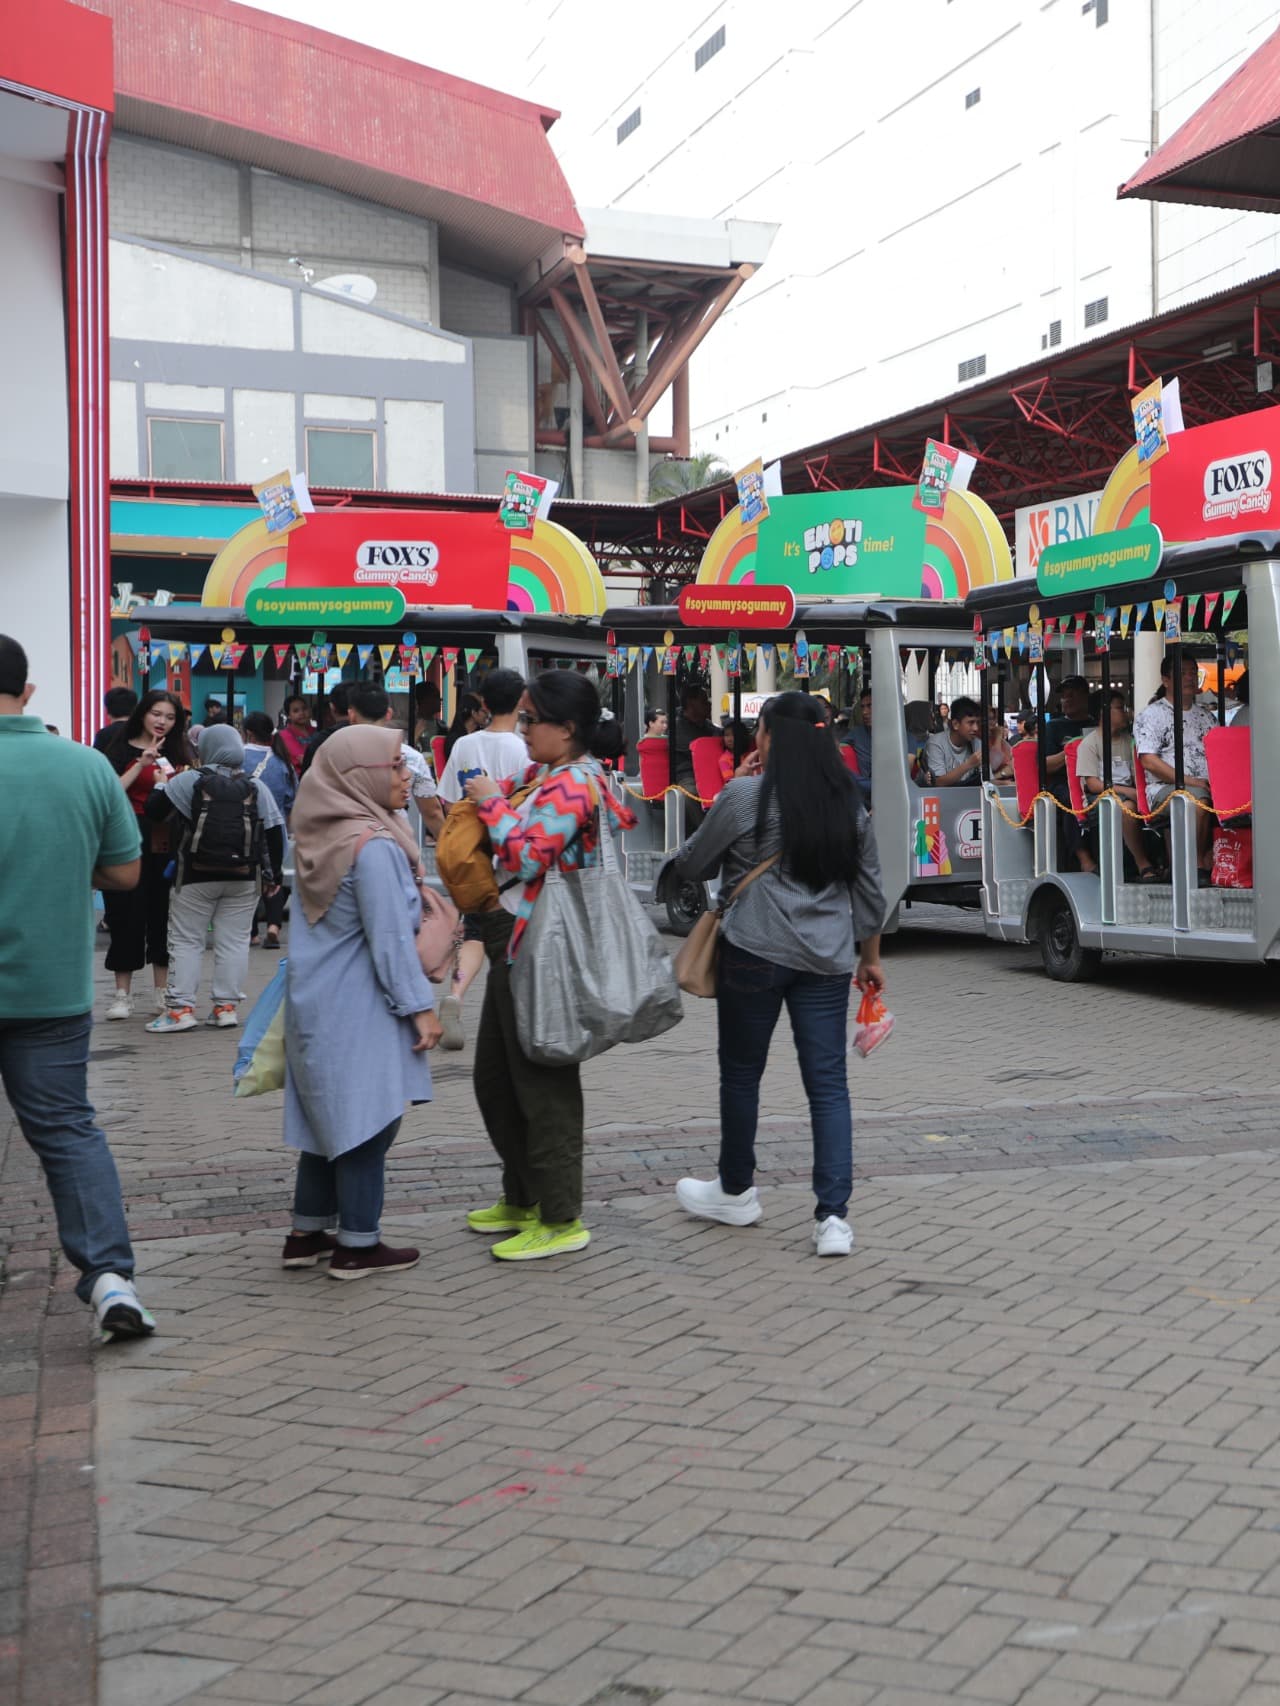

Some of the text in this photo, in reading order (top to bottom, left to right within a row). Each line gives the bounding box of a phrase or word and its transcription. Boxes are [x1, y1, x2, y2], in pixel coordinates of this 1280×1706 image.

[1211, 458, 1265, 496] FOX'S
[1204, 491, 1270, 518] Gummy Candy
[366, 546, 431, 567] FOX'S
[784, 541, 800, 556] It's
[808, 545, 858, 574] POPS
[863, 536, 895, 552] time!
[1043, 543, 1152, 577] #soyummysogummy
[356, 570, 436, 585] Gummy Candy
[255, 598, 393, 615] #soyummysogummy
[685, 596, 787, 615] #soyummysogummy
